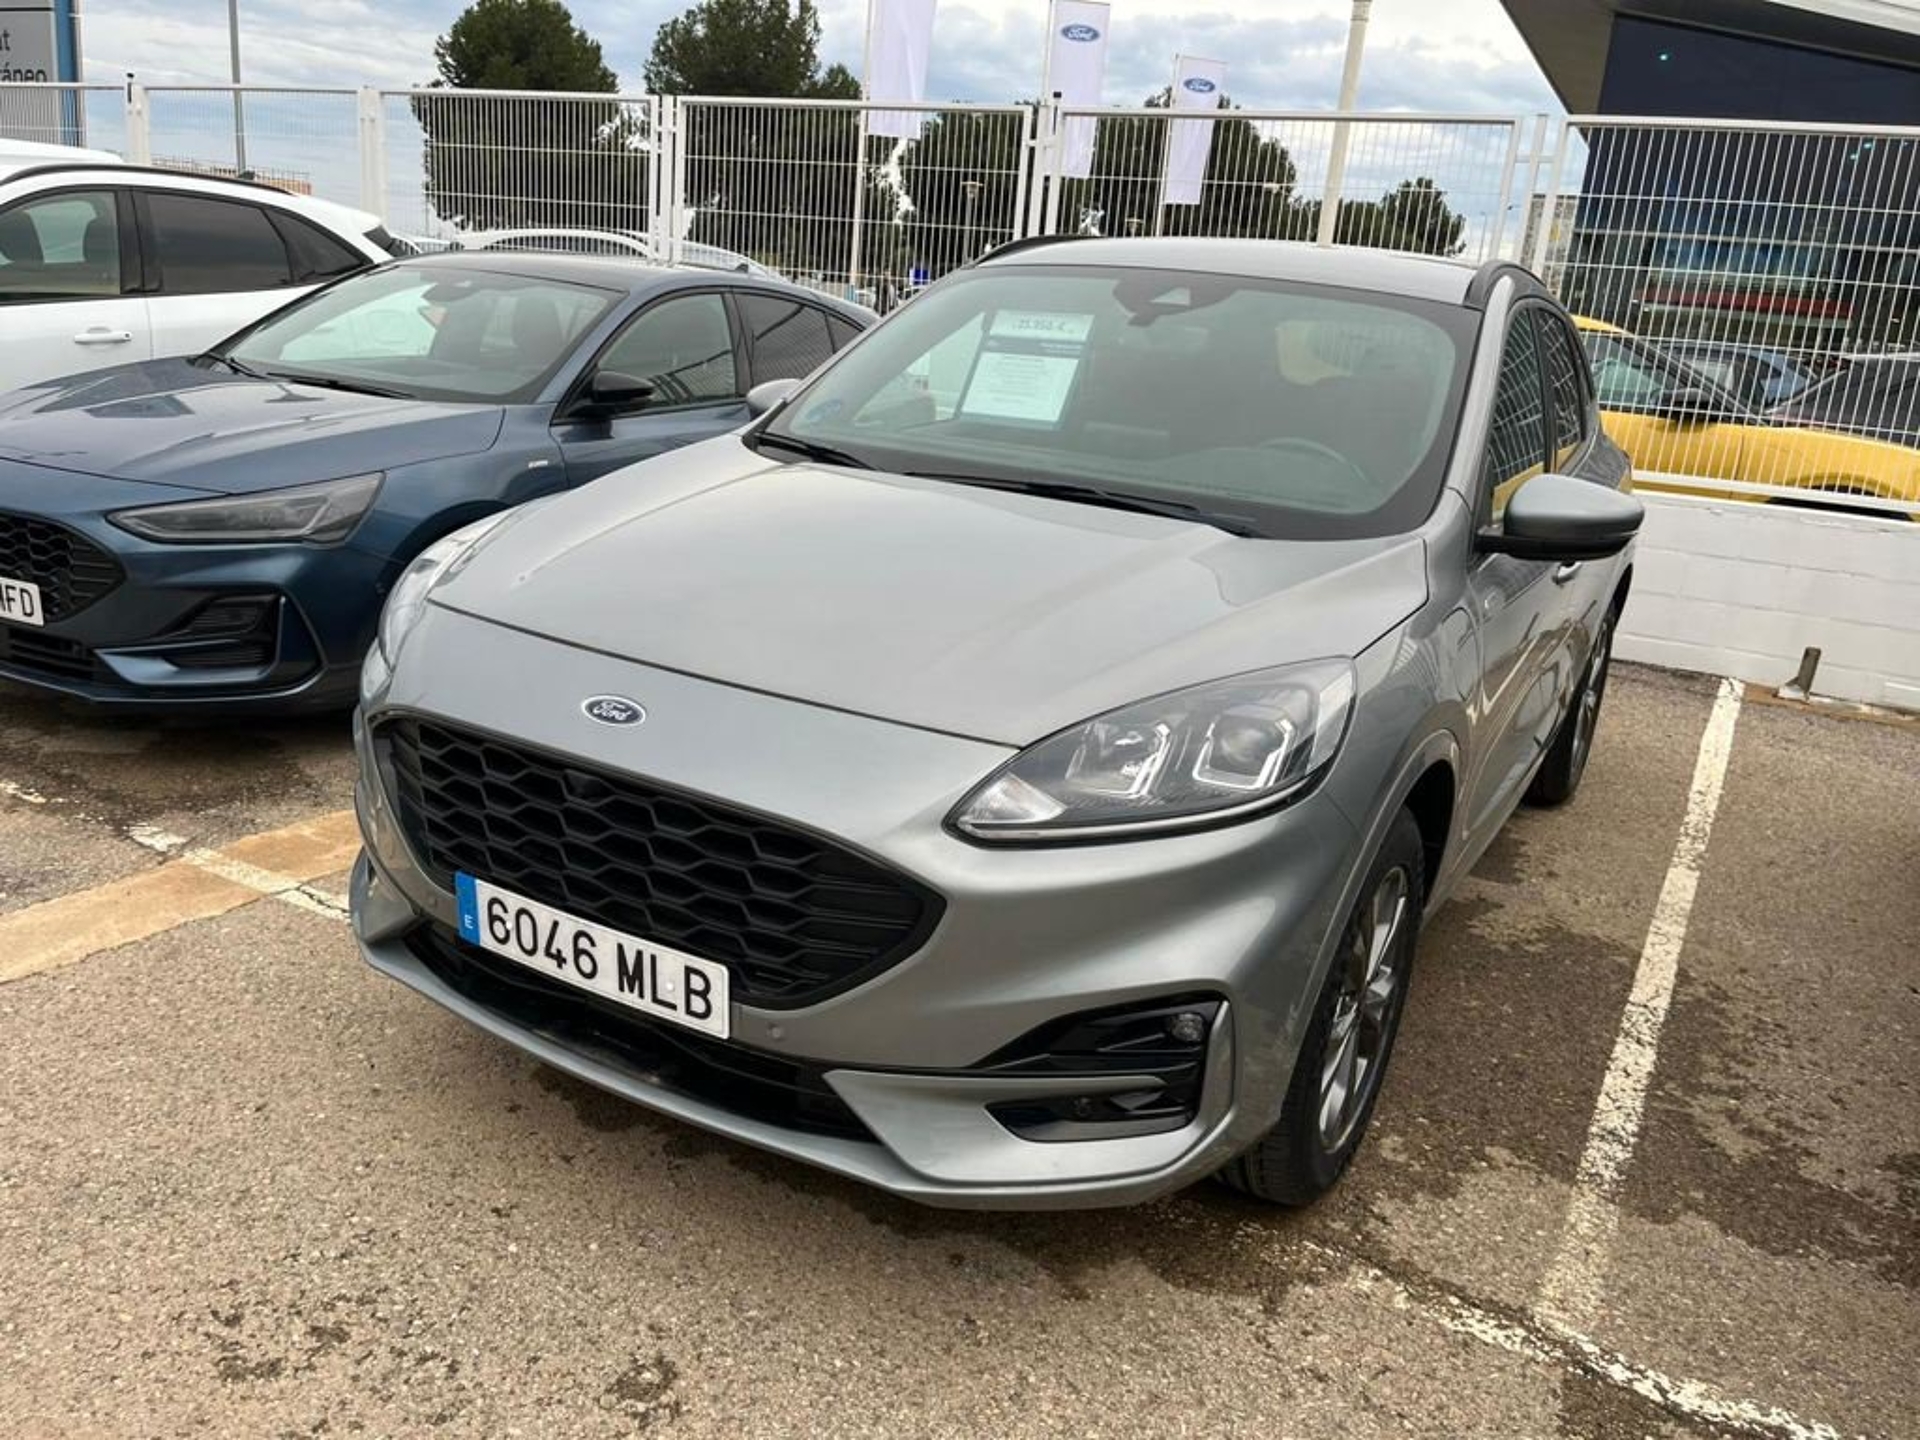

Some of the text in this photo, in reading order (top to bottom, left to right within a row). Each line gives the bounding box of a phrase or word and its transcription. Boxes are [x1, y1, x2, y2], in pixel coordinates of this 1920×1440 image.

[0, 29, 10, 51] t
[464, 914, 474, 929] E
[487, 897, 713, 1020] 6046 MLB
